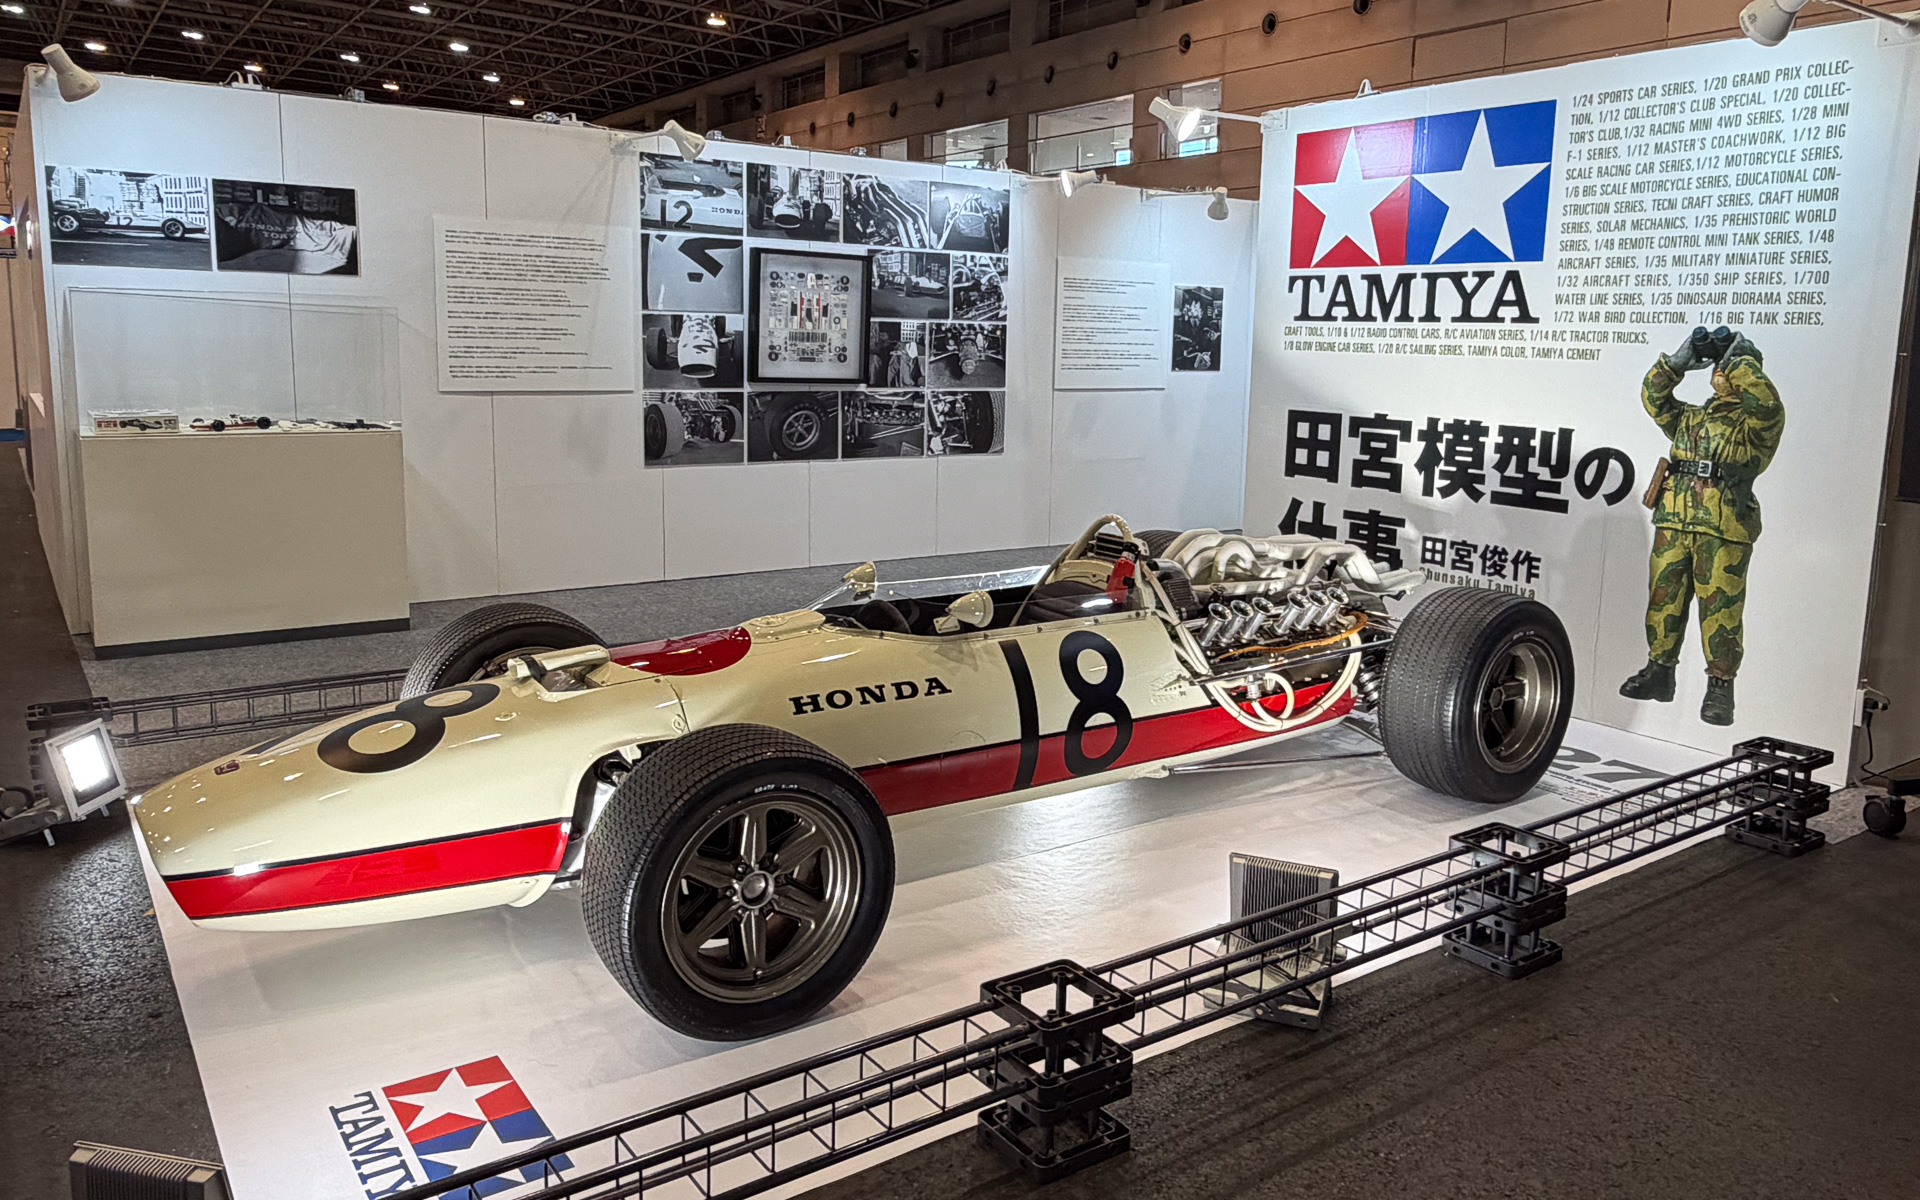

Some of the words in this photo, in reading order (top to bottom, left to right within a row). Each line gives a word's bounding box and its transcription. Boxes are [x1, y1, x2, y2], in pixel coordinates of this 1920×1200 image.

[1573, 94, 1593, 107] 1/24
[1598, 89, 1633, 105] SPORTS
[1638, 86, 1657, 100] CAR
[1661, 81, 1697, 97] SERIES,
[1704, 76, 1727, 91] 1/20
[1733, 71, 1770, 87] GRAND
[1775, 66, 1802, 82] PRIX
[1807, 60, 1854, 78] COLLEC-
[1571, 113, 1593, 126] TION,
[1599, 109, 1620, 123] 1/12
[1624, 101, 1686, 120] COLLECTOR'S
[1690, 98, 1716, 112] CLUB
[1720, 92, 1766, 109] SPECIAL,
[1774, 87, 1798, 102] 1/20
[1804, 82, 1851, 99] COLLEC-
[1569, 130, 1594, 144] TOR'S
[1649, 121, 1685, 136] RACING
[1689, 117, 1712, 132] MINI
[1717, 114, 1741, 128] 4WD
[1747, 110, 1785, 126] SERIES,
[1792, 106, 1817, 121] 1/28
[1822, 102, 1849, 118] MINI
[1567, 149, 1582, 162] F-1
[1587, 146, 1621, 160] SERIES,
[1627, 143, 1649, 157] 1/12
[1654, 138, 1706, 155] MASTER'S
[1711, 130, 1785, 149] COACHWORK,
[1794, 126, 1820, 142] 1/12
[1826, 124, 1846, 139] BIG
[1566, 167, 1593, 180] SCALE
[1597, 164, 1631, 178] RACING
[1635, 162, 1654, 175] CAR
[1725, 149, 1796, 168] MOTORCYCLE
[1801, 145, 1843, 161] SERIES,
[1566, 186, 1579, 198] 1/6
[1583, 184, 1597, 197] BIG
[1600, 182, 1627, 196] SCALE
[1630, 177, 1692, 193] MOTORCYCLE
[1696, 175, 1731, 189] SERIES,
[1736, 169, 1808, 186] EDUCATIONAL
[1813, 167, 1841, 181] CON-
[1563, 202, 1610, 216] STRUCTION
[1614, 200, 1647, 214] SERIES,
[1652, 198, 1677, 211] TECNI
[1682, 195, 1713, 209] CRAFT
[1717, 193, 1753, 207] SERIES,
[1759, 190, 1793, 205] CRAFT
[1797, 187, 1839, 203] HUMOR
[1561, 221, 1592, 234] SERIES,
[1597, 220, 1626, 232] SOLAR
[1631, 216, 1688, 231] MECHANICS,
[1695, 214, 1717, 228] 1/35
[1722, 211, 1790, 226] PREHISTORIC
[1796, 208, 1836, 223] WORLD
[1559, 239, 1590, 252] SERIES,
[1595, 239, 1614, 250] 1/48
[1618, 237, 1655, 250] REMOTE
[1658, 235, 1701, 249] CONTROL
[1705, 234, 1728, 246] MINI
[1733, 232, 1760, 246] TANK
[1764, 231, 1803, 245] SERIES,
[1809, 229, 1834, 243] 1/48
[1558, 257, 1601, 269] AIRCRAFT
[1605, 256, 1639, 269] SERIES,
[1645, 255, 1667, 268] 1/35
[1672, 254, 1721, 268] MILITARY
[1725, 251, 1785, 265] MINIATURE
[1790, 250, 1832, 264] SERIES,
[1557, 275, 1578, 287] 1/32
[1583, 275, 1630, 287] AIRCRAFT
[1635, 274, 1671, 287] SERIES,
[1679, 273, 1709, 286] 1/350
[1714, 272, 1739, 285] SHIP
[1744, 272, 1786, 285] SERIES,
[1794, 271, 1829, 284] 1/700
[1288, 269, 1540, 324] TAMIYA
[1555, 293, 1586, 305] WATER
[1590, 293, 1608, 305] LINE
[1612, 293, 1645, 306] SERIES,
[1651, 293, 1672, 305] 1/35
[1677, 292, 1727, 305] DINOSAUR
[1732, 292, 1782, 305] DIORAMA
[1787, 292, 1827, 305] SERIES,
[1284, 326, 1303, 336] CRAFT
[1305, 327, 1324, 337] TOOLS,
[1327, 327, 1341, 337] 1/10
[1351, 327, 1365, 338] 1/12
[1367, 328, 1387, 338] RADIO
[1389, 328, 1418, 339] CONTROL
[1421, 328, 1442, 340] CARS,
[1444, 328, 1458, 339] R/C
[1460, 329, 1496, 340] AVIATION
[1498, 329, 1526, 341] SERIES,
[1531, 330, 1549, 341] 1/14
[1552, 330, 1567, 342] R/C
[1570, 331, 1609, 343] TRACTOR
[1612, 331, 1649, 344] TRUCKS,
[1554, 311, 1574, 323] 1/72
[1579, 311, 1600, 323] WAR
[1604, 311, 1625, 323] BIRD
[1630, 312, 1688, 324] COLLECTION,
[1699, 311, 1722, 324] 1/16
[1727, 312, 1744, 324] BIG
[1750, 312, 1779, 325] TANK
[1784, 312, 1824, 326] SERIES,
[1284, 341, 1294, 350] 1/8
[1295, 341, 1313, 351] GLOW
[1315, 341, 1336, 352] ENGINE
[1338, 342, 1350, 352] CAR
[1352, 343, 1375, 353] SERIES,
[1378, 343, 1393, 353] 1/20
[1395, 343, 1407, 354] R/C
[1409, 344, 1436, 355] SAILING
[1439, 345, 1464, 356] SERIES,
[1468, 345, 1497, 357] TAMIYA
[1501, 346, 1527, 358] COLOR,
[1531, 347, 1563, 359] TAMIYA
[1567, 348, 1601, 360] CEMENT
[1284, 409, 1636, 513] 田宮模型の
[1421, 536, 1541, 584] 田宮俊作
[788, 676, 952, 717] HONDA
[998, 630, 1134, 791] 18
